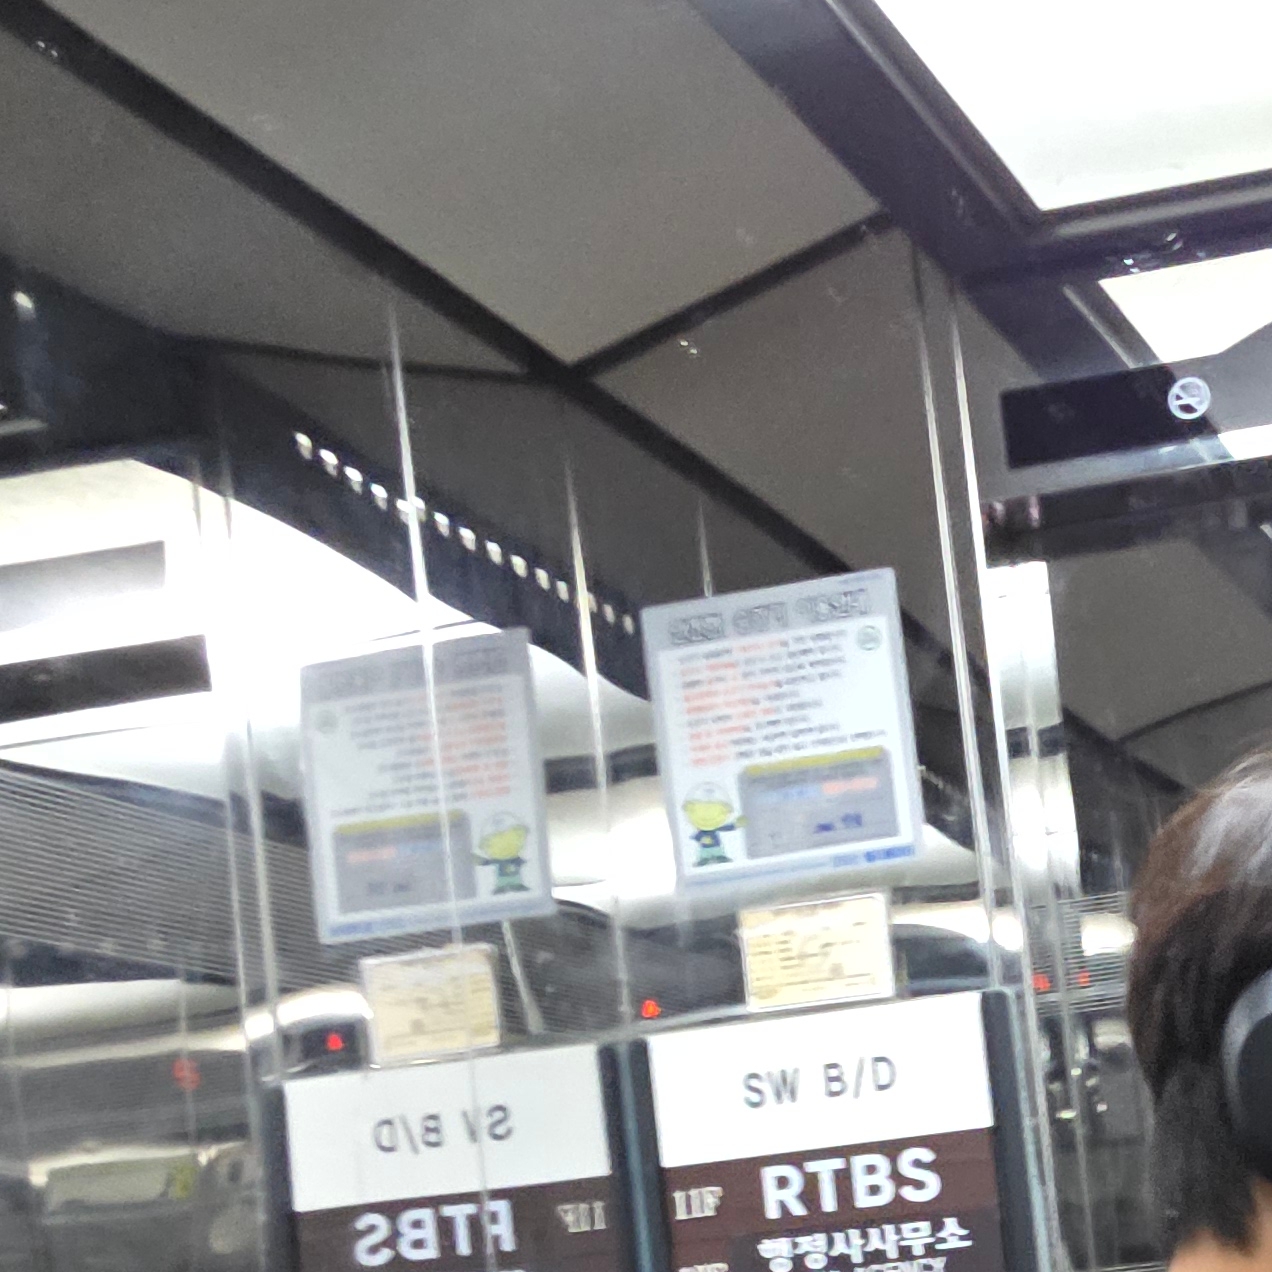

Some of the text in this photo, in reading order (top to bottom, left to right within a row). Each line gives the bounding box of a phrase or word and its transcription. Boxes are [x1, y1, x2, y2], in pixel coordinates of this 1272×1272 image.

[744, 1056, 898, 1109] SW B/D
[760, 1147, 943, 1220] RTBS
